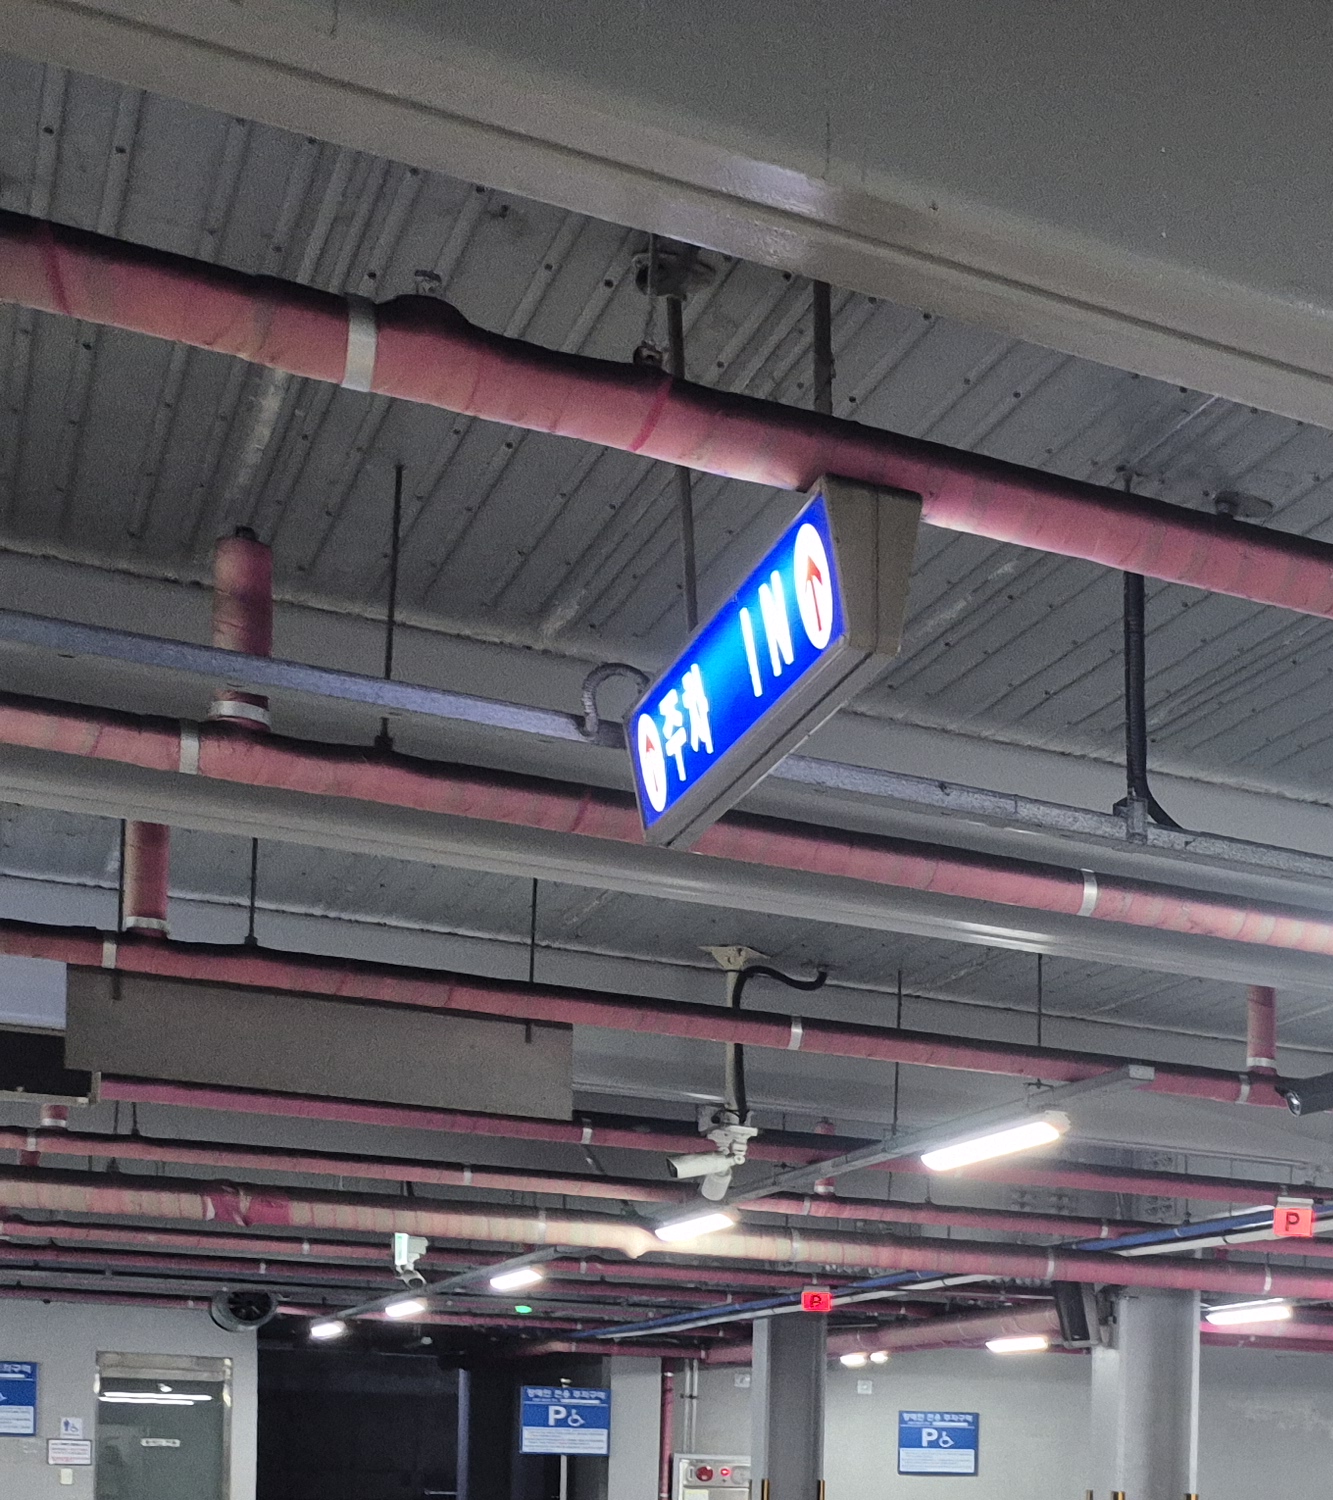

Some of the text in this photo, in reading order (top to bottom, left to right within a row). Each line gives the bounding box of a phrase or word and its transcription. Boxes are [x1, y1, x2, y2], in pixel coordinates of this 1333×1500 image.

[659, 570, 795, 781] 주차 IN
[1285, 1211, 1300, 1231] P
[548, 1405, 567, 1426] P
[921, 1428, 938, 1447] P
